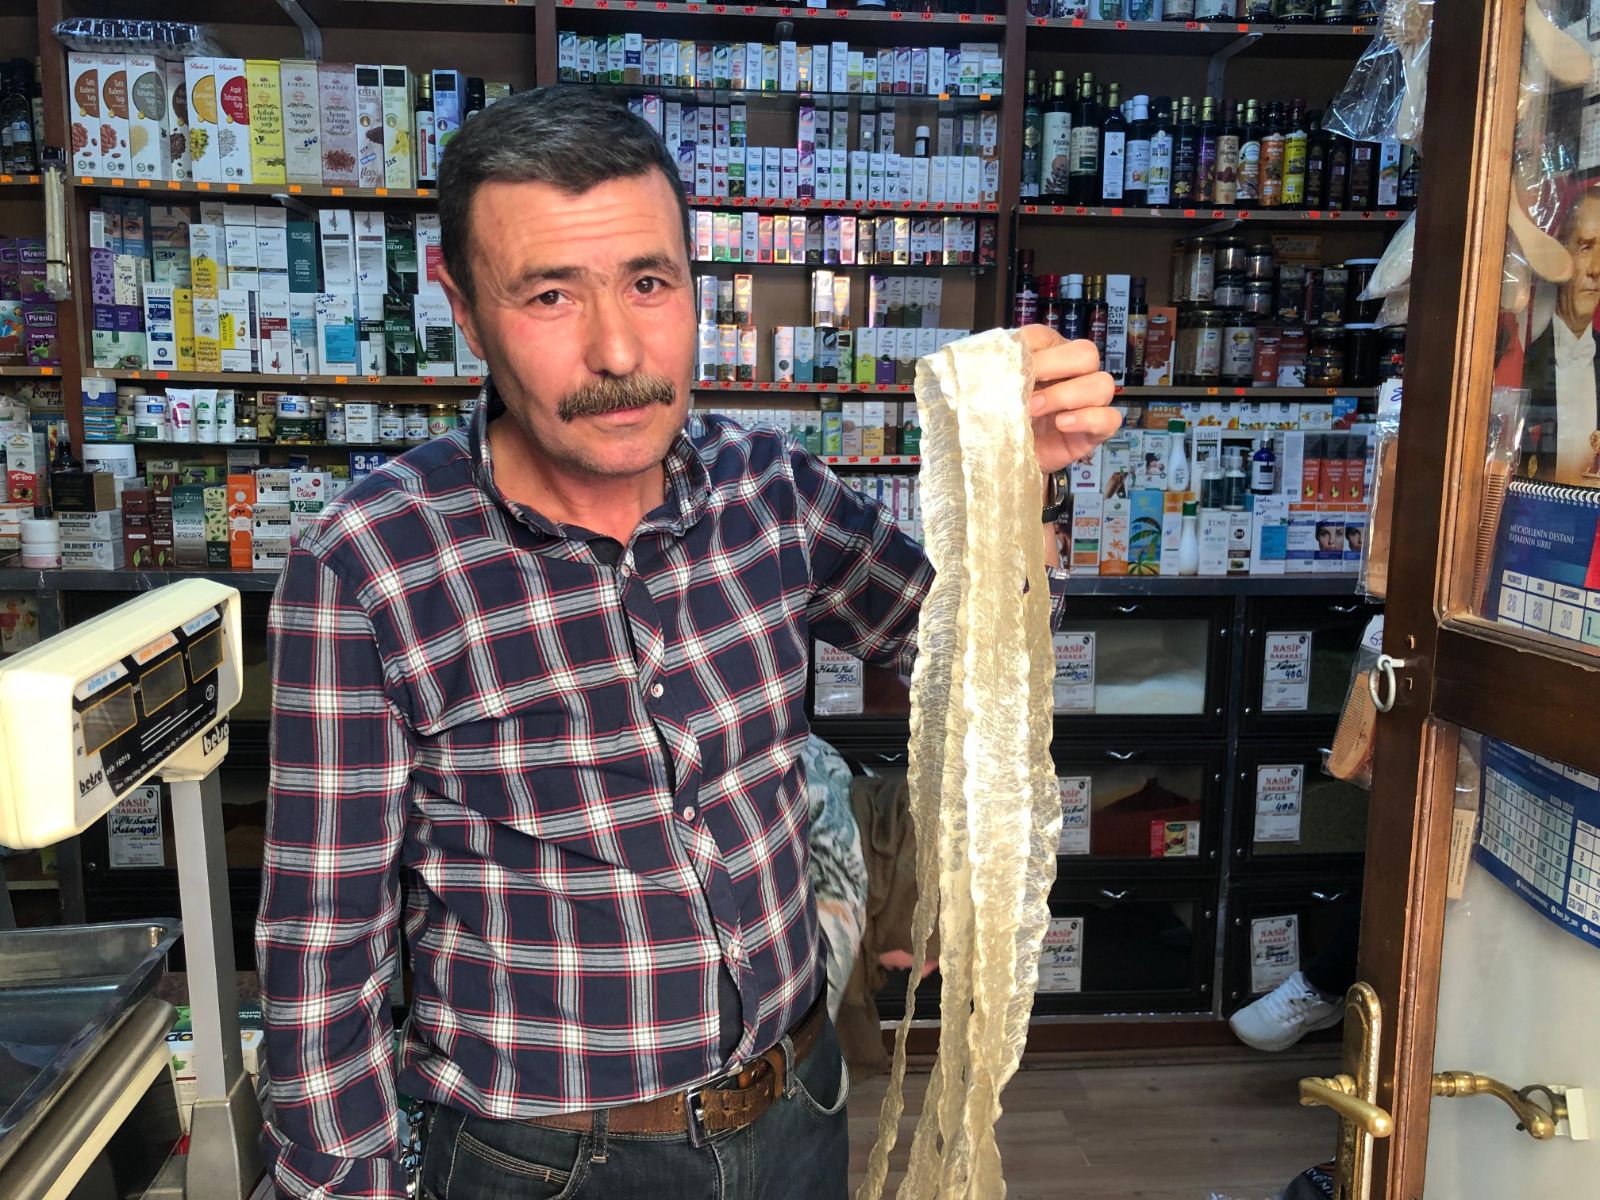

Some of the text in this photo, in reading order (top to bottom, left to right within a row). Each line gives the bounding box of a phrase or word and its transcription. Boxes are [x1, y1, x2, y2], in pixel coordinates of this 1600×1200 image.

[294, 501, 307, 512] X2
[1510, 524, 1575, 545] MÜCADELENİN DESTANI
[1508, 533, 1535, 548] BAŞARININ
[1507, 593, 1592, 636] 28 29 30 1
[1056, 644, 1085, 653] NASİP
[1273, 643, 1301, 652] NASİP
[1265, 776, 1294, 785] NASİP
[1059, 788, 1080, 798] ASİP
[119, 799, 149, 808] NASİP
[1261, 927, 1289, 938] NASİP
[1258, 937, 1290, 945] BAHARAT
